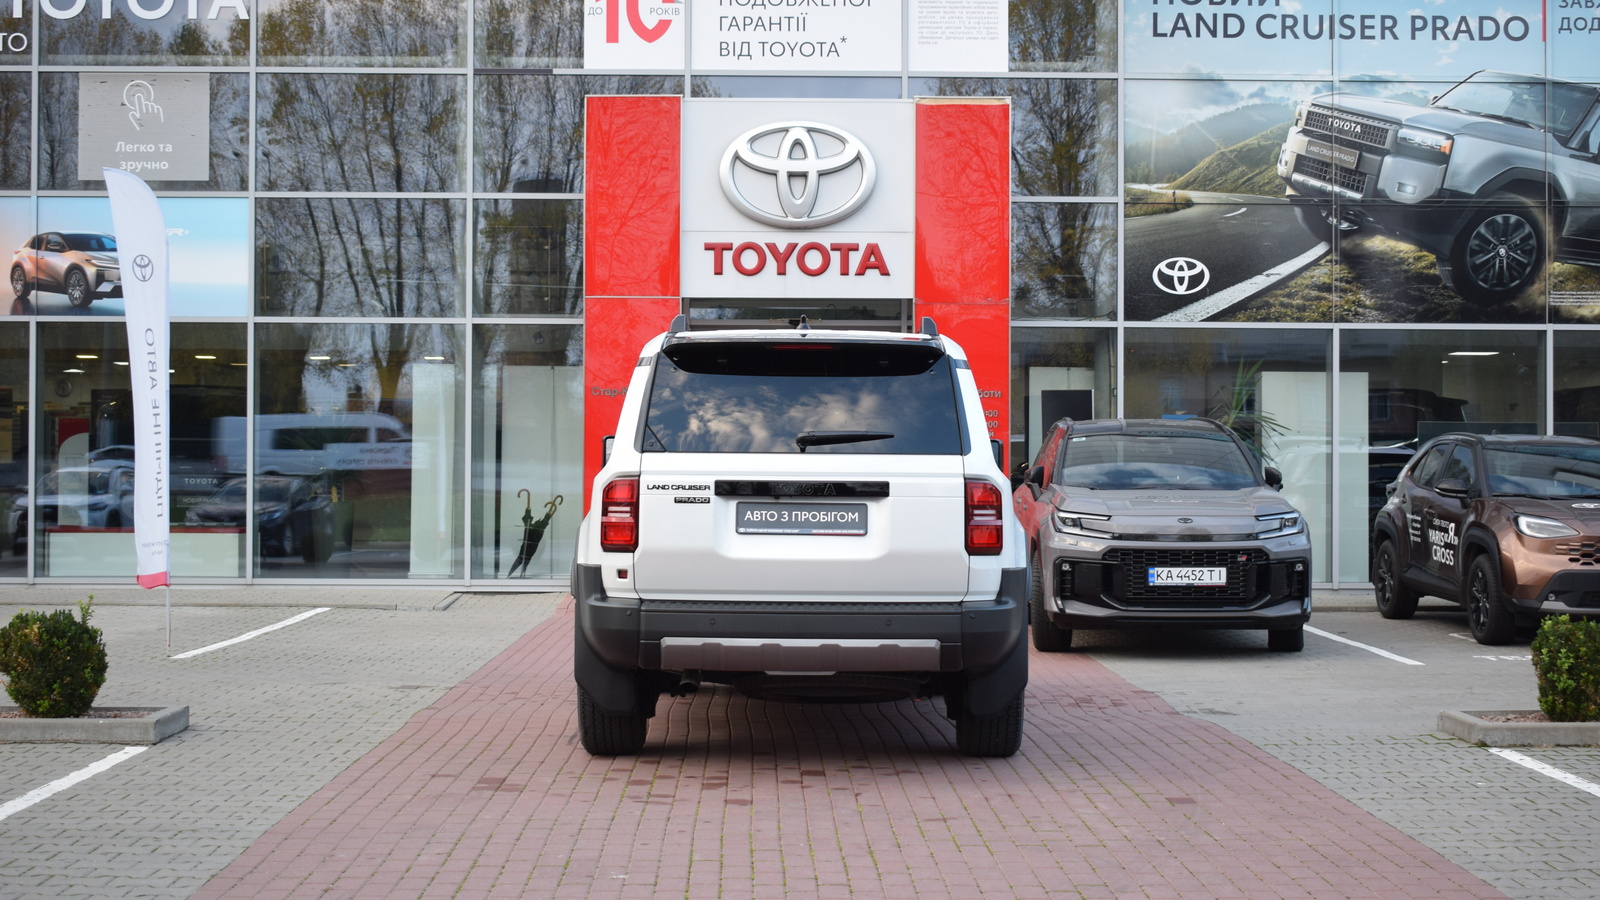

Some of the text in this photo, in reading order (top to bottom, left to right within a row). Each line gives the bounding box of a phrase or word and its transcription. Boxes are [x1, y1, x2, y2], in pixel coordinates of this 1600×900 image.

[1558, 0, 1600, 8] ЗАВ
[588, 7, 603, 16] ДО
[649, 7, 681, 15] РОКІВ
[719, 13, 808, 32] ГАРАНТІЇ
[1152, 12, 1530, 42] LAND CRUISER PRADO
[719, 41, 752, 60] ВІД
[1328, 118, 1361, 133] TOYOTA
[115, 141, 173, 152] Легко та
[119, 160, 169, 172] зручно
[704, 241, 891, 277] TOYOTA
[978, 388, 1002, 398] боти
[744, 510, 860, 522] АВТО З ПРОБІГОМ
[1428, 528, 1445, 546] YARIS
[1432, 545, 1455, 566] CROSS
[1156, 569, 1174, 581] KA
[1176, 569, 1205, 581] 4452
